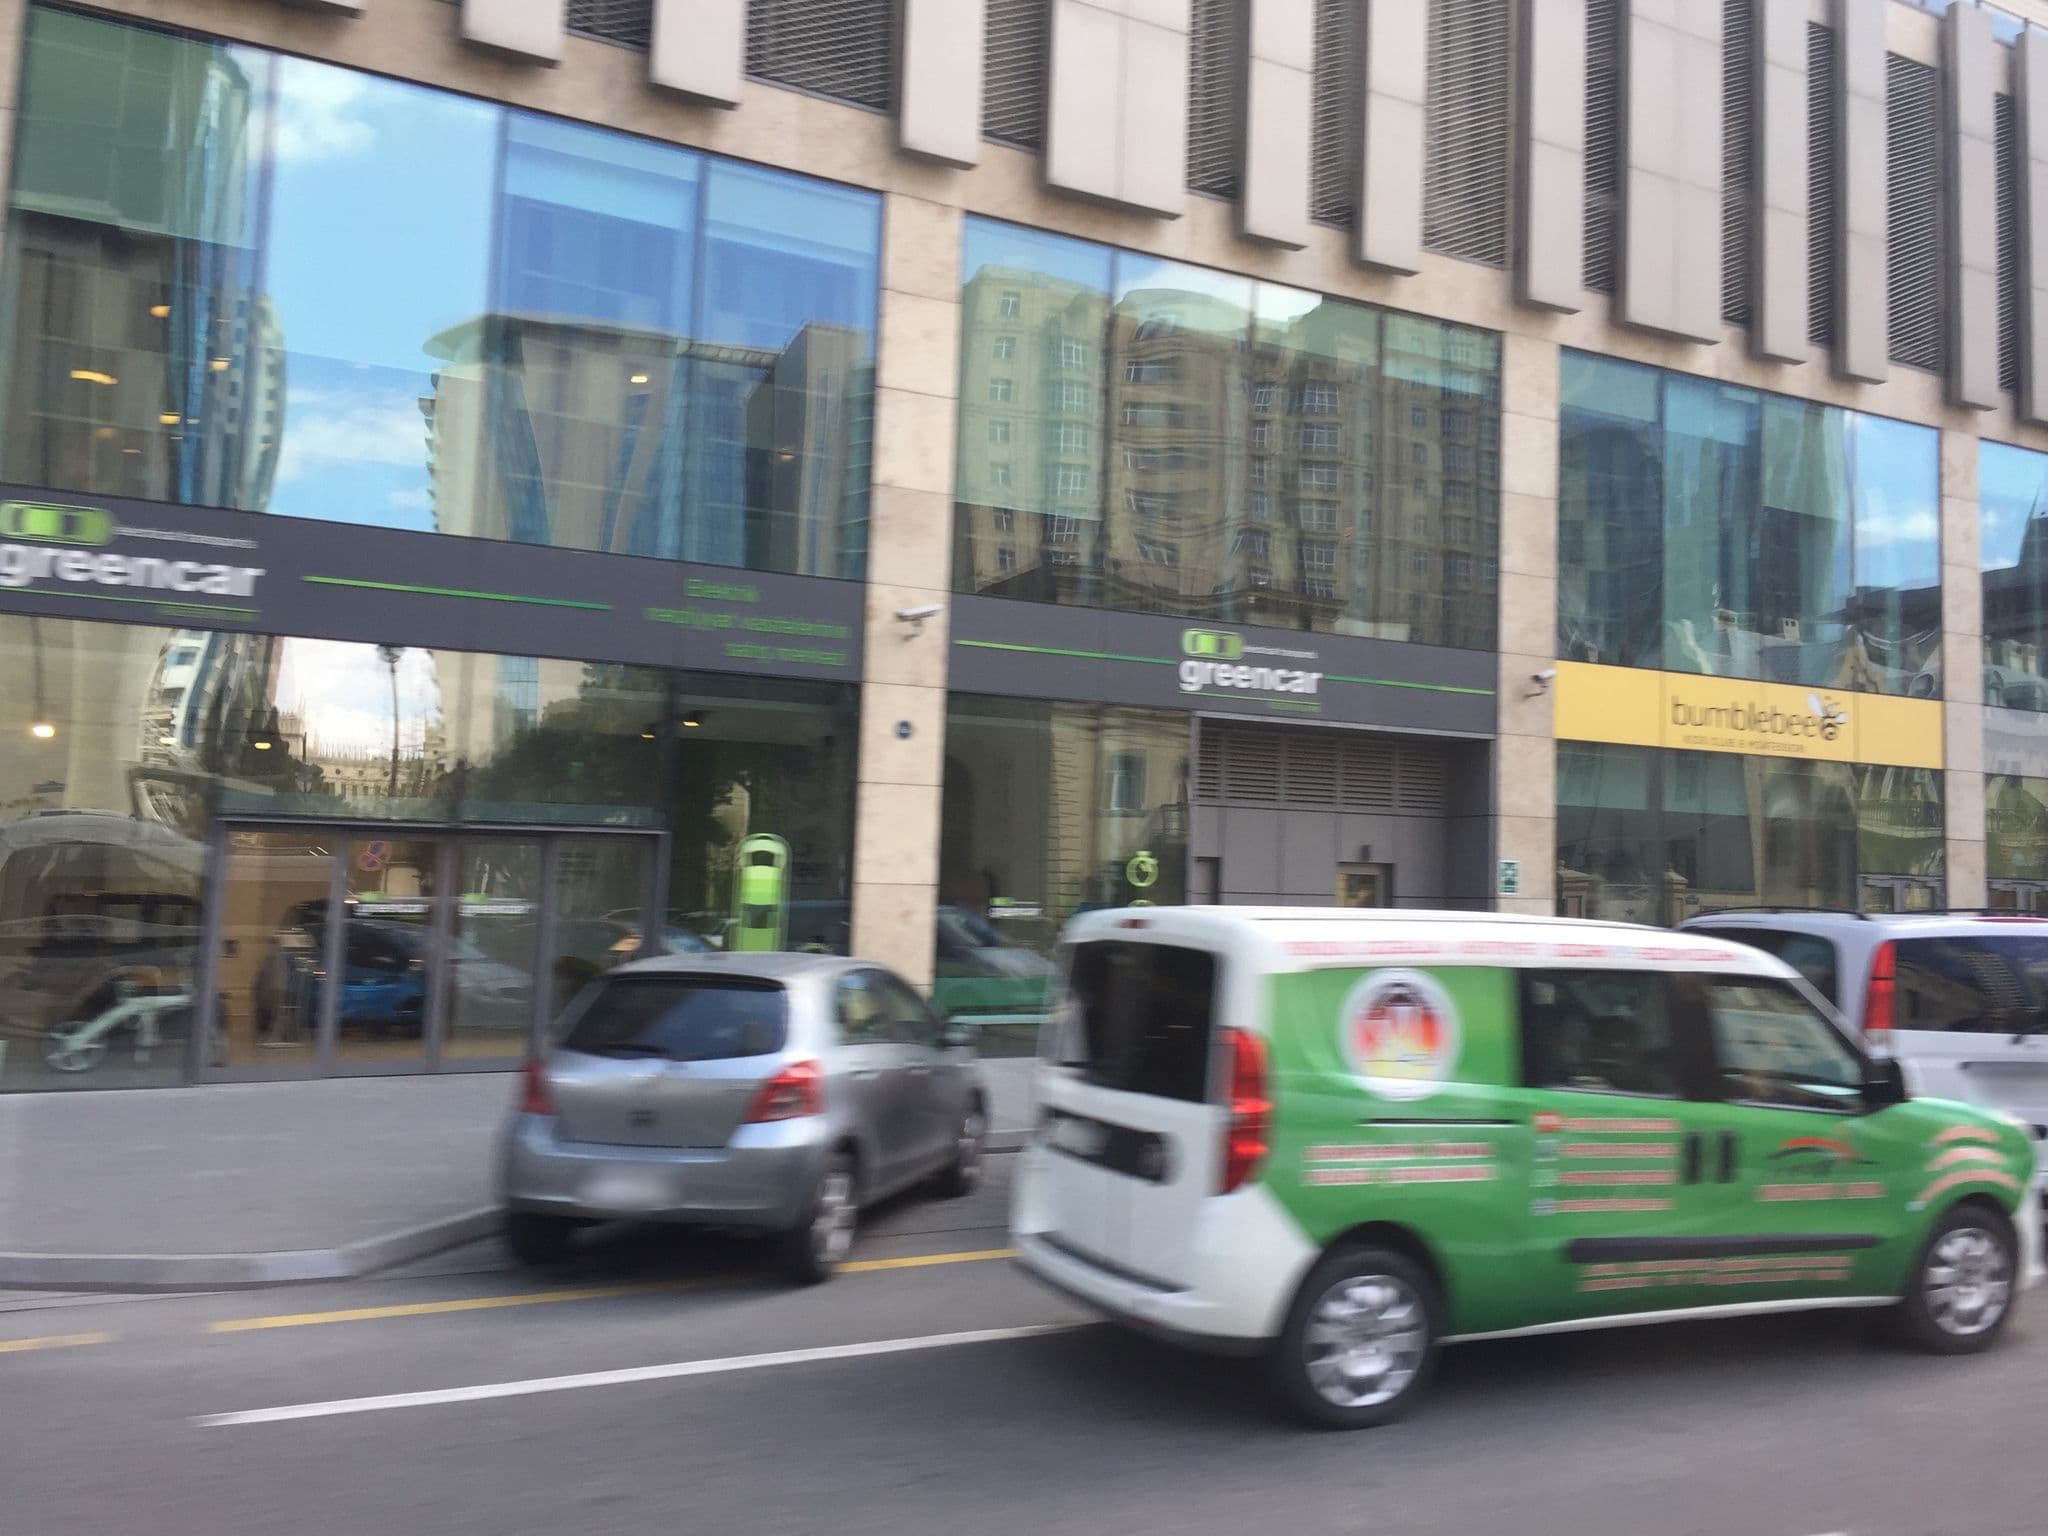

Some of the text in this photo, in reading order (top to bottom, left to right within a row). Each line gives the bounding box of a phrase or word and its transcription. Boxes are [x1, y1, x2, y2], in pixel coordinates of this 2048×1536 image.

[0, 543, 266, 596] greencar
[1179, 660, 1323, 694] greencar
[1671, 695, 1817, 737] bumblebee
